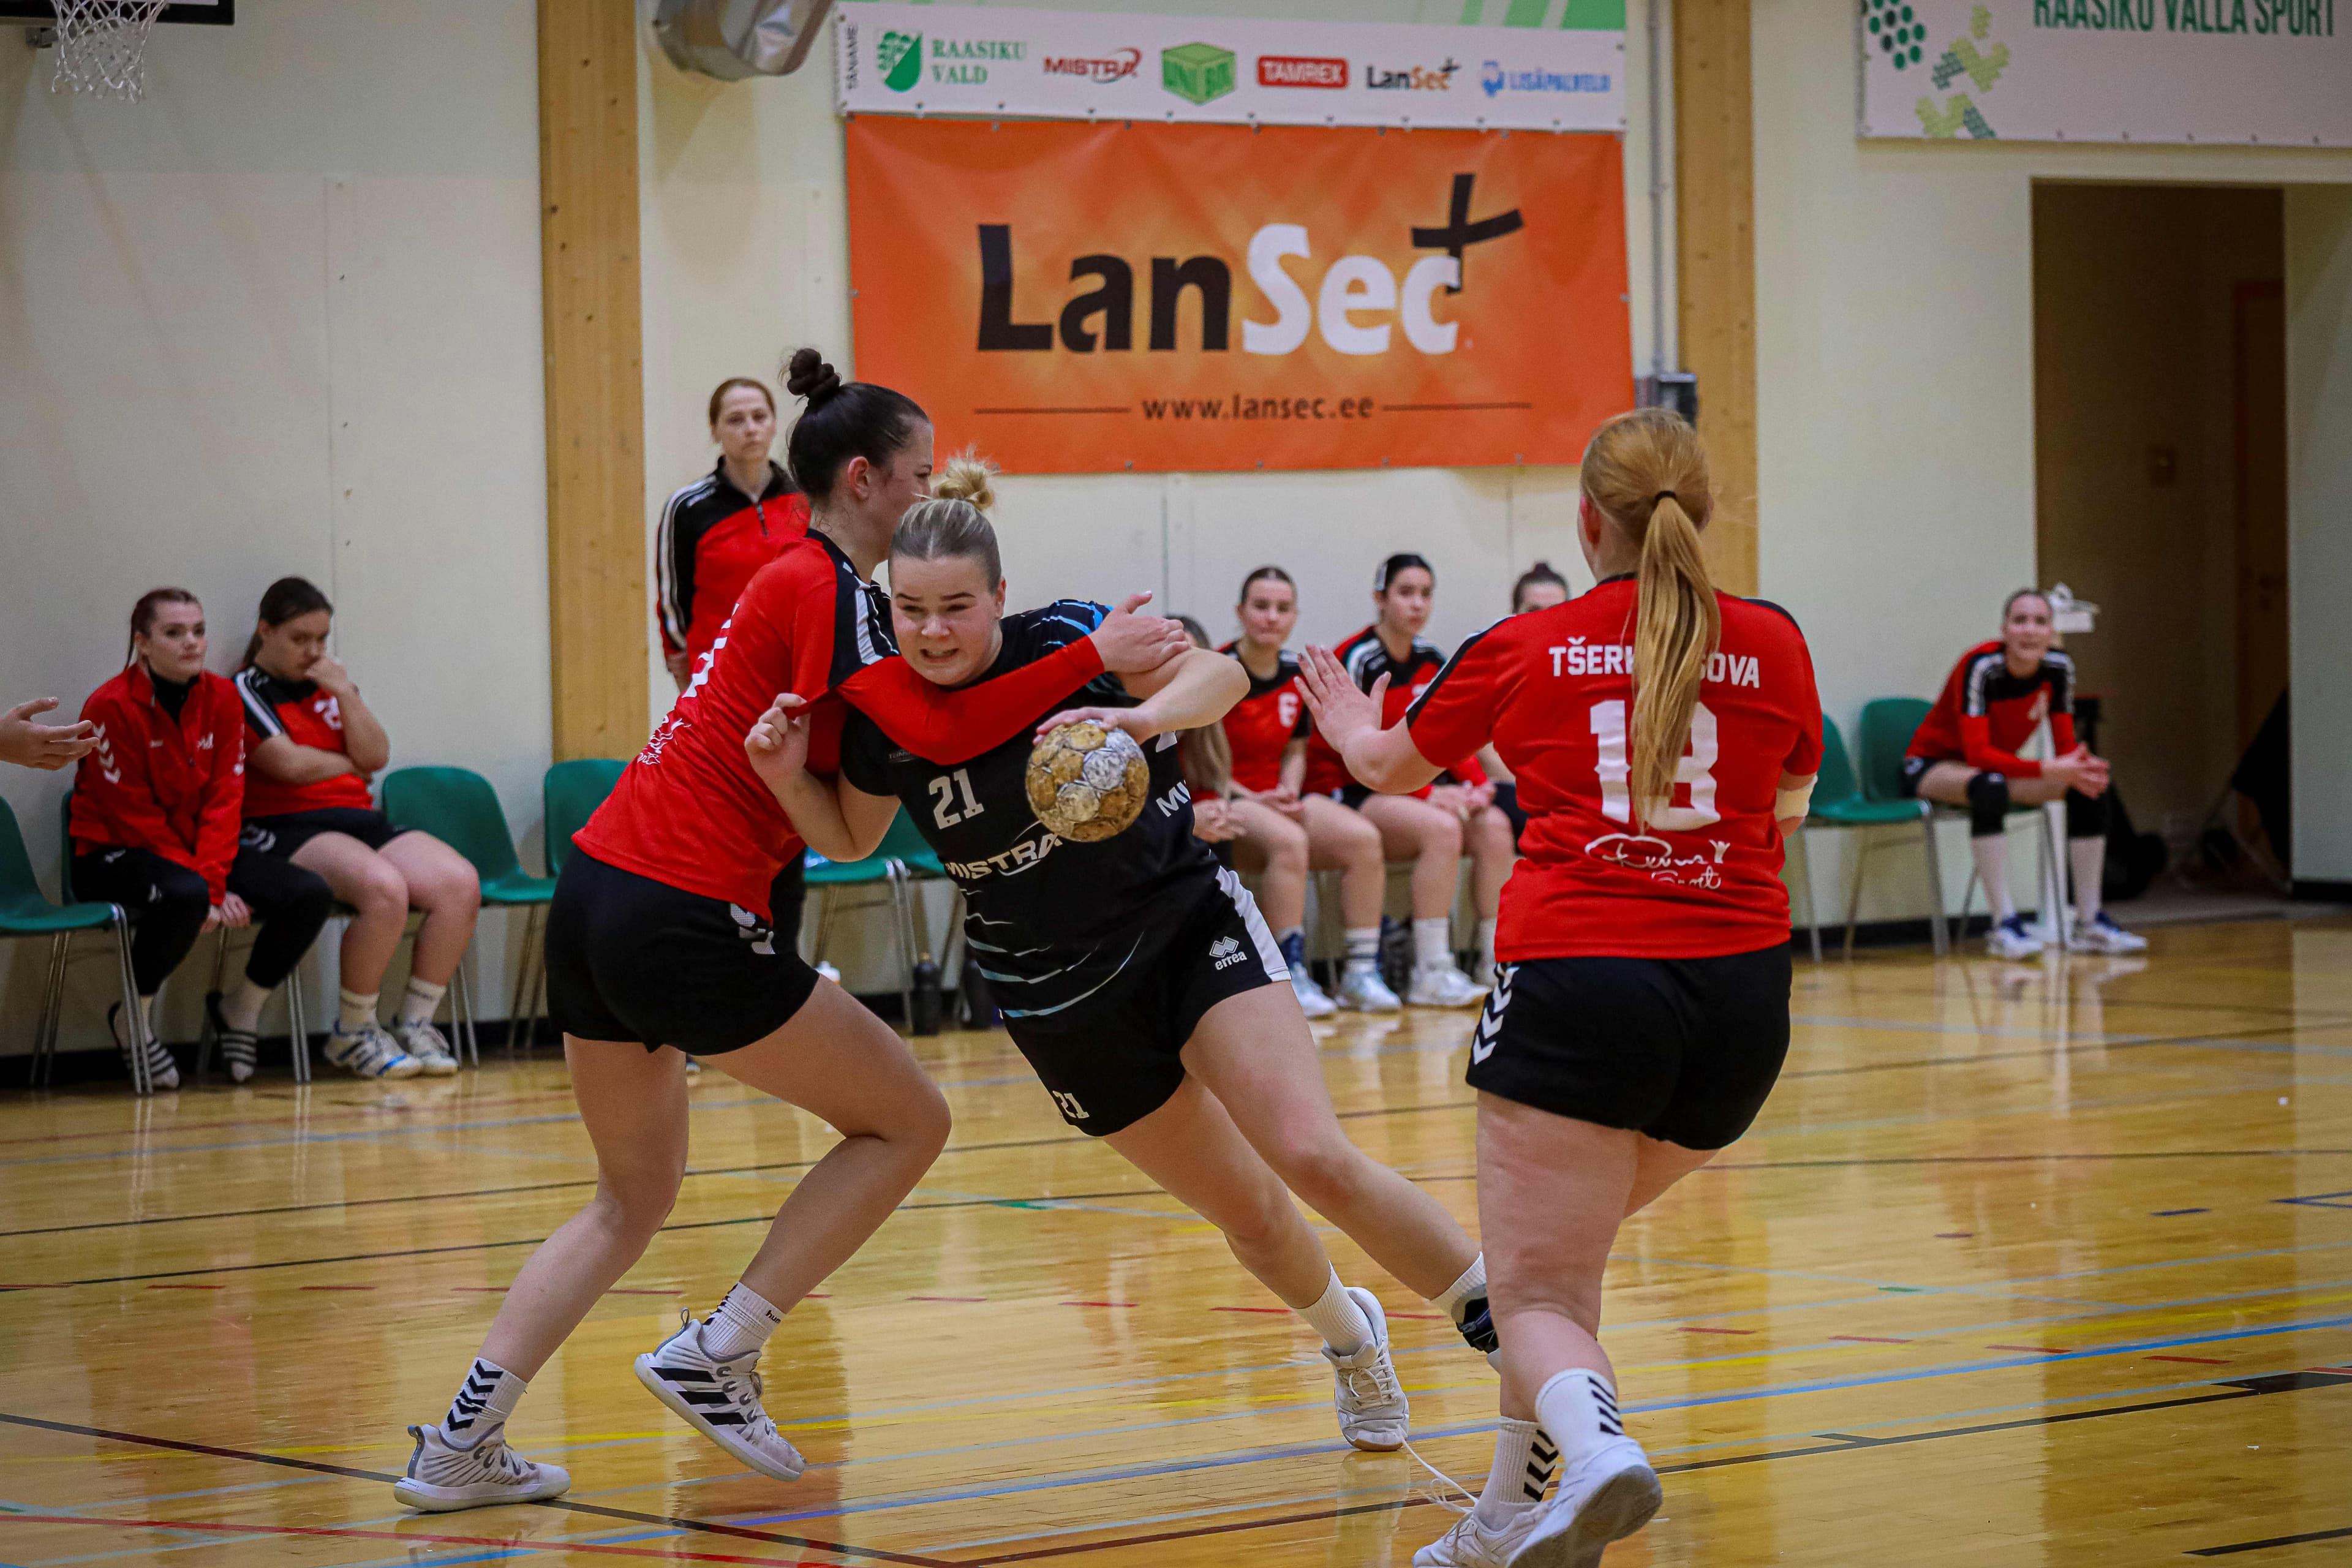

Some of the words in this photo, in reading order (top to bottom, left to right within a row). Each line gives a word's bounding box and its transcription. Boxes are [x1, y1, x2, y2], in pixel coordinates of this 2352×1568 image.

[2033, 0, 2154, 31] RAASIKU
[2163, 0, 2248, 34] VALLA
[932, 39, 1028, 60] RAASIKU
[1044, 56, 1137, 77] MISTRA
[931, 64, 988, 85] VALD
[1142, 393, 1374, 420] www.lansec.ee
[1549, 636, 1760, 689] TŠEROVA
[1590, 699, 1722, 832] 18
[929, 768, 985, 830] 21
[945, 833, 1063, 880] MISTRA
